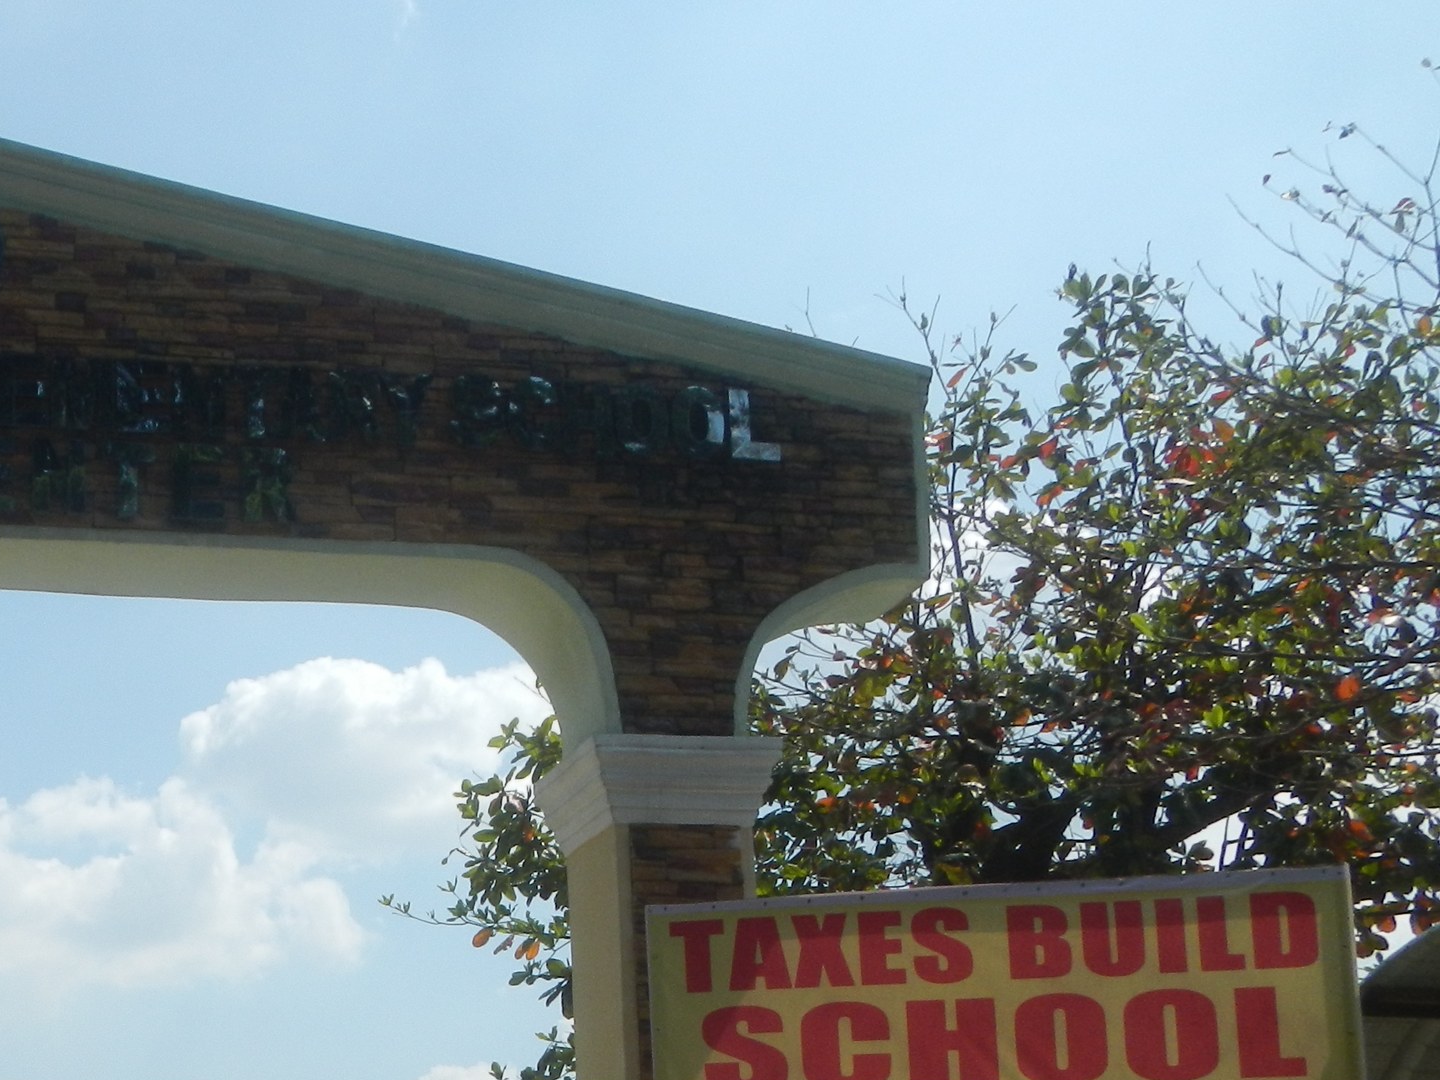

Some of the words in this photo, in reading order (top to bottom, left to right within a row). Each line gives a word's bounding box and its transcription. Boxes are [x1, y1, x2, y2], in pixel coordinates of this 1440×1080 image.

[449, 374, 782, 463] SCHOOL
[668, 906, 974, 994] TAXES
[1005, 891, 1320, 980] BUILD
